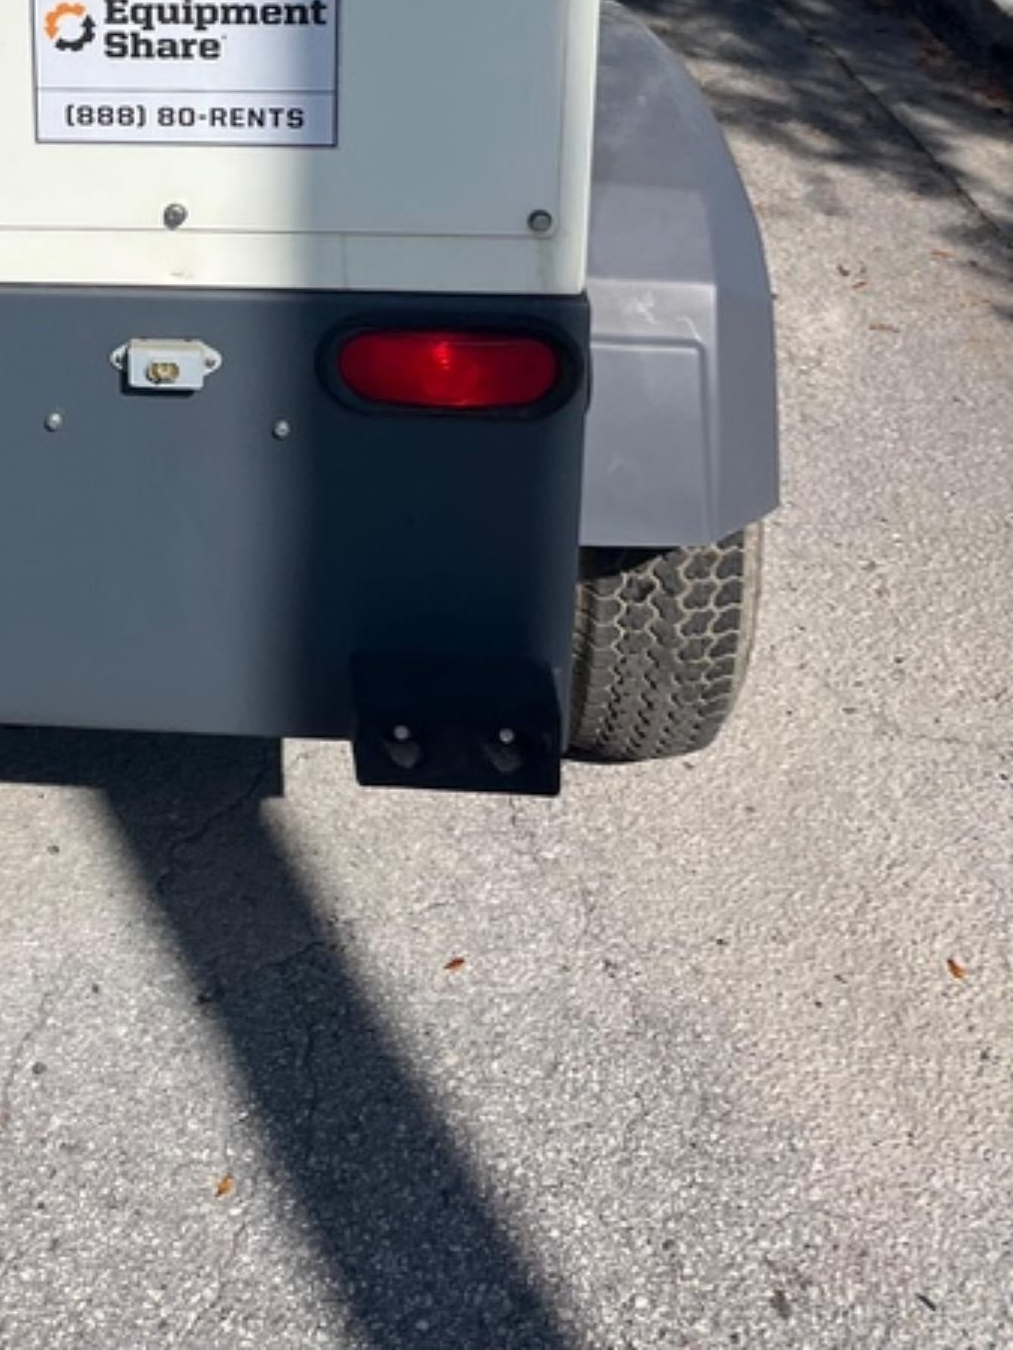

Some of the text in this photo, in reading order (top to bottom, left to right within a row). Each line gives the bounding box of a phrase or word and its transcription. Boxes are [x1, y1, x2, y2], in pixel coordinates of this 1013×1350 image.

[104, 31, 221, 60] Share
[65, 104, 305, 130] (888) 80-RENTS
